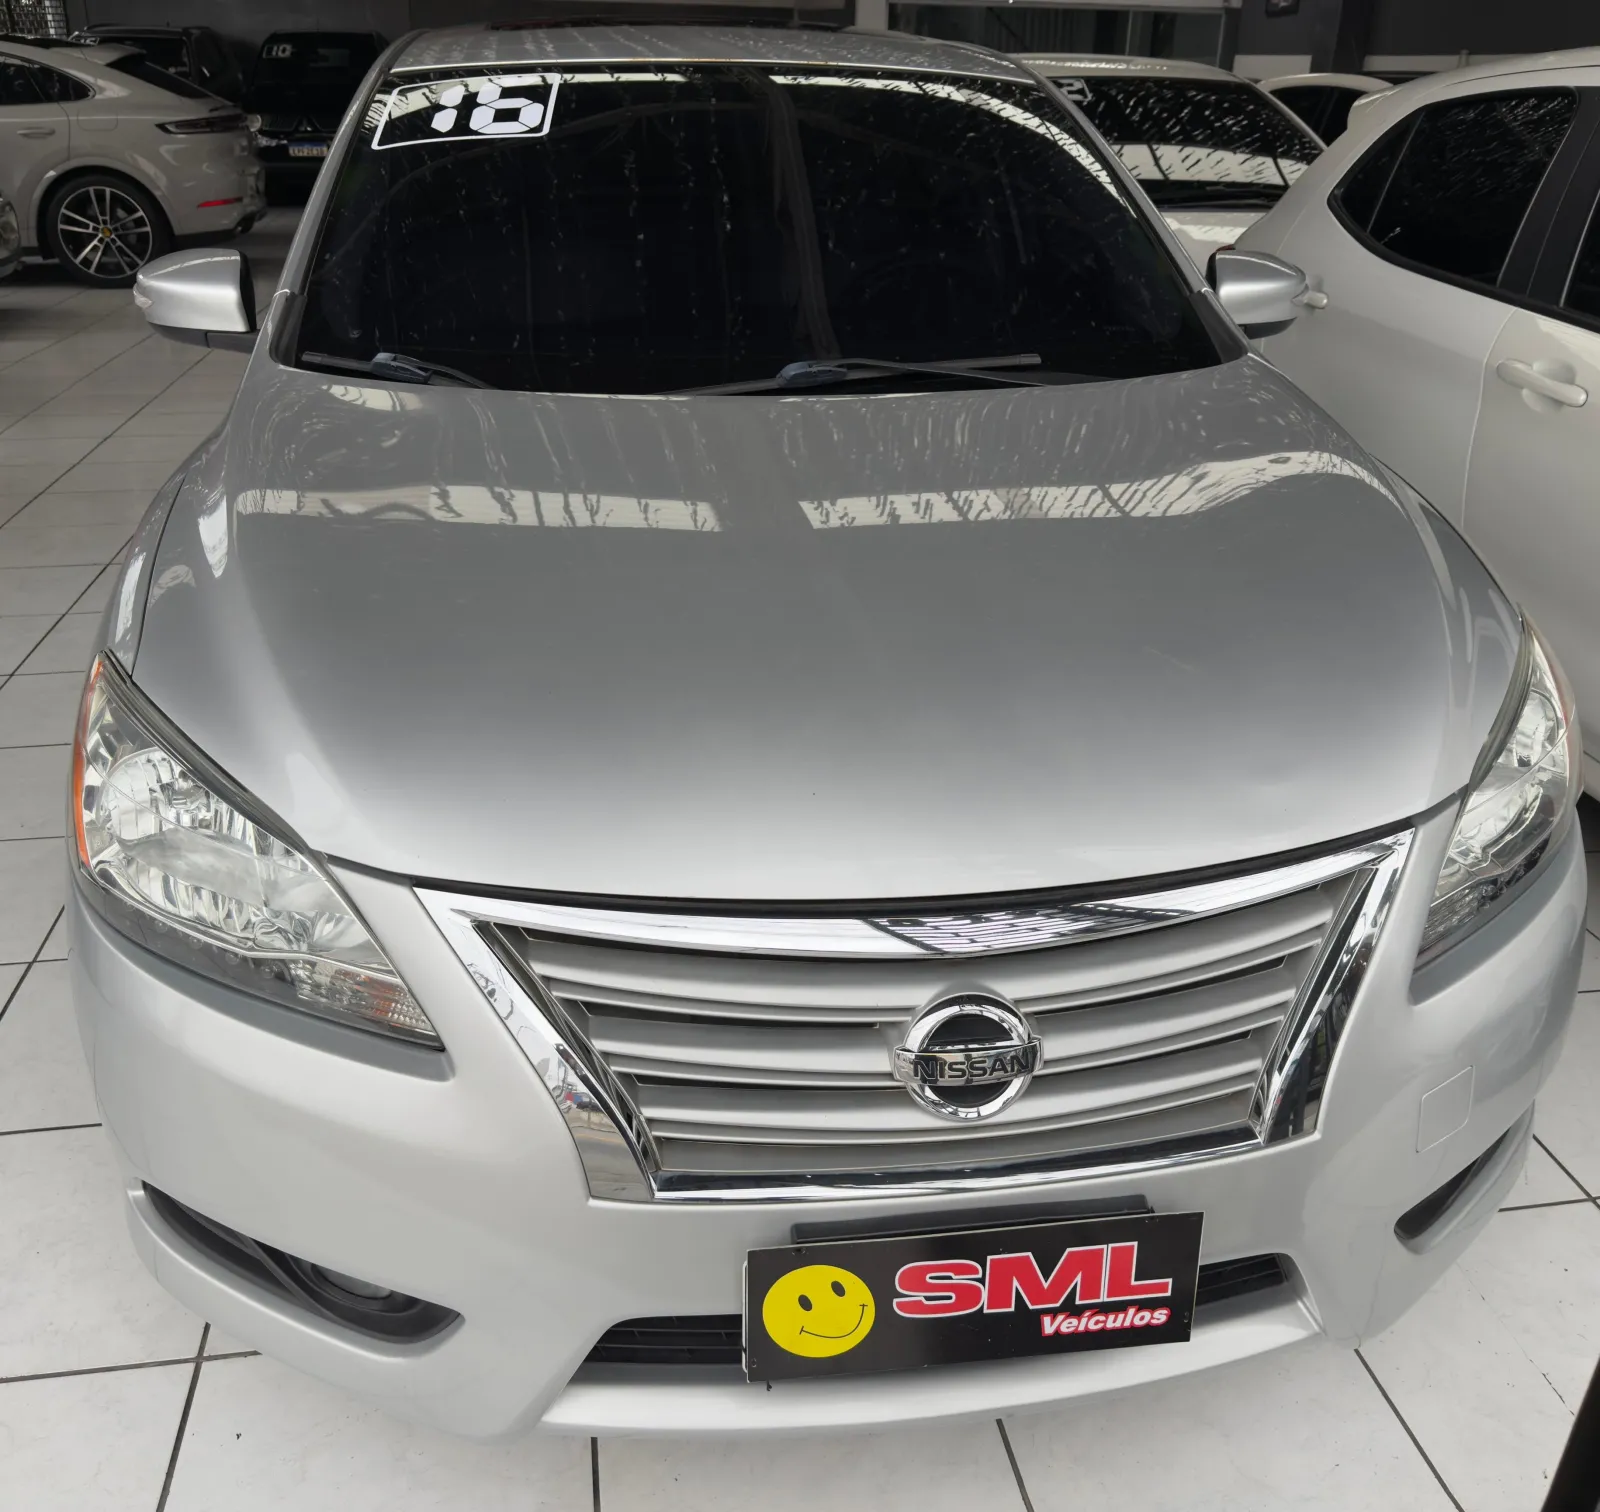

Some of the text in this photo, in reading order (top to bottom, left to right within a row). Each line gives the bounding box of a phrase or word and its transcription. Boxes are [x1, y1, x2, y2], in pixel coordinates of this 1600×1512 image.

[431, 76, 544, 134] 16
[913, 1054, 1030, 1079] NISSAN
[893, 1241, 1172, 1318] SML
[1041, 1305, 1170, 1337] Veículos
